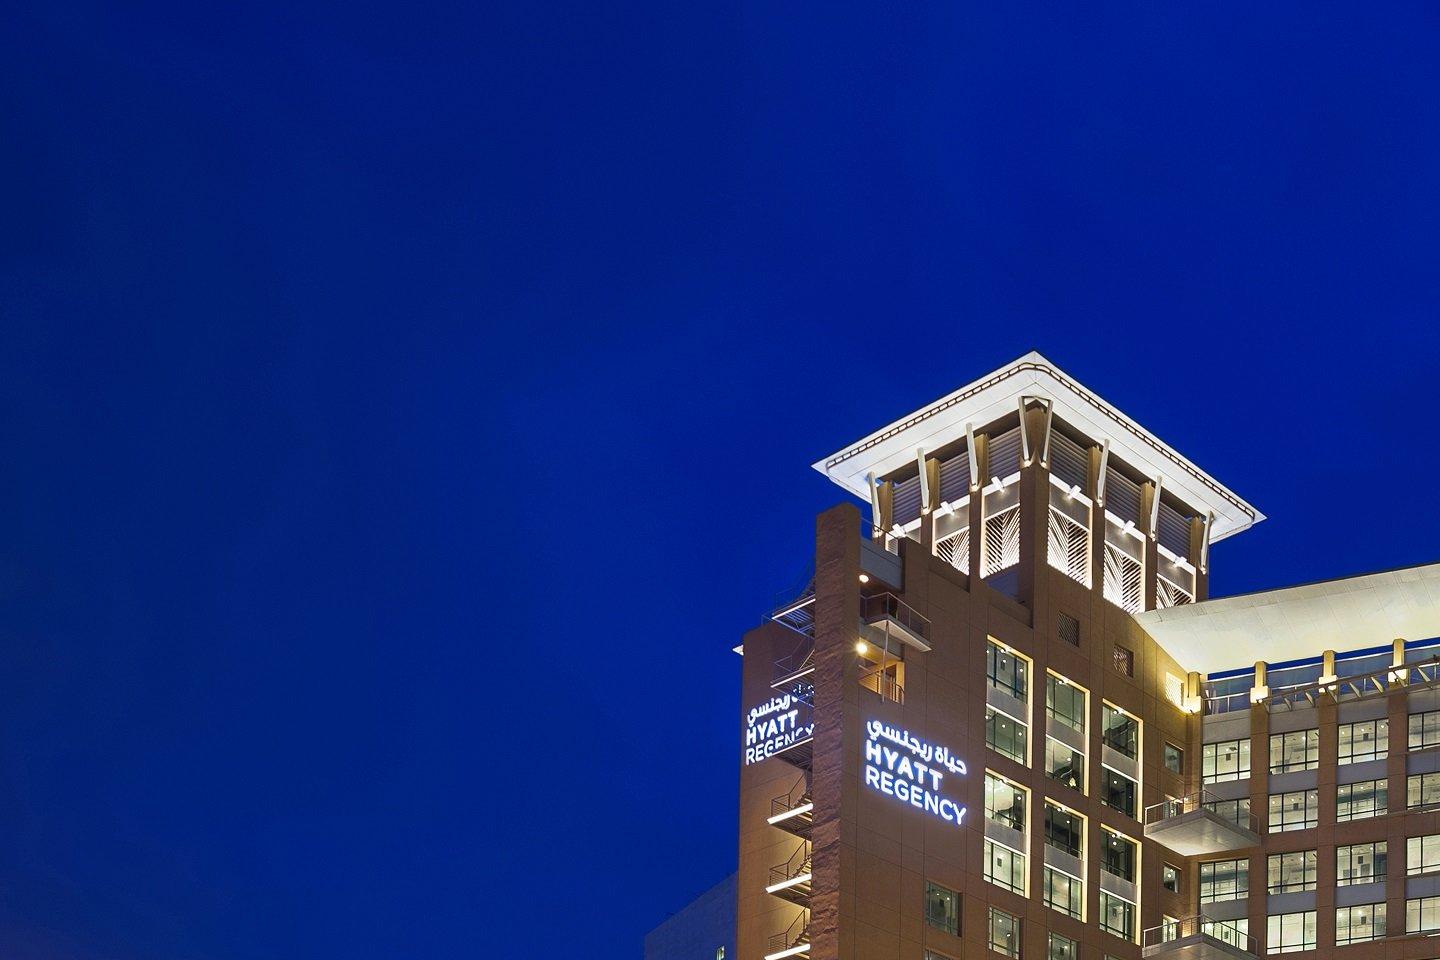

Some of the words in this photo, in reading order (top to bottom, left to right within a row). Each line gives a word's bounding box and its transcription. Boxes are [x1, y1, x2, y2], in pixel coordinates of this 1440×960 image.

[746, 709, 798, 746] HYATT
[866, 720, 933, 762] ريجنسي
[866, 739, 943, 791] HYATT
[935, 746, 967, 775] حياة
[865, 764, 967, 825] REGENCY
